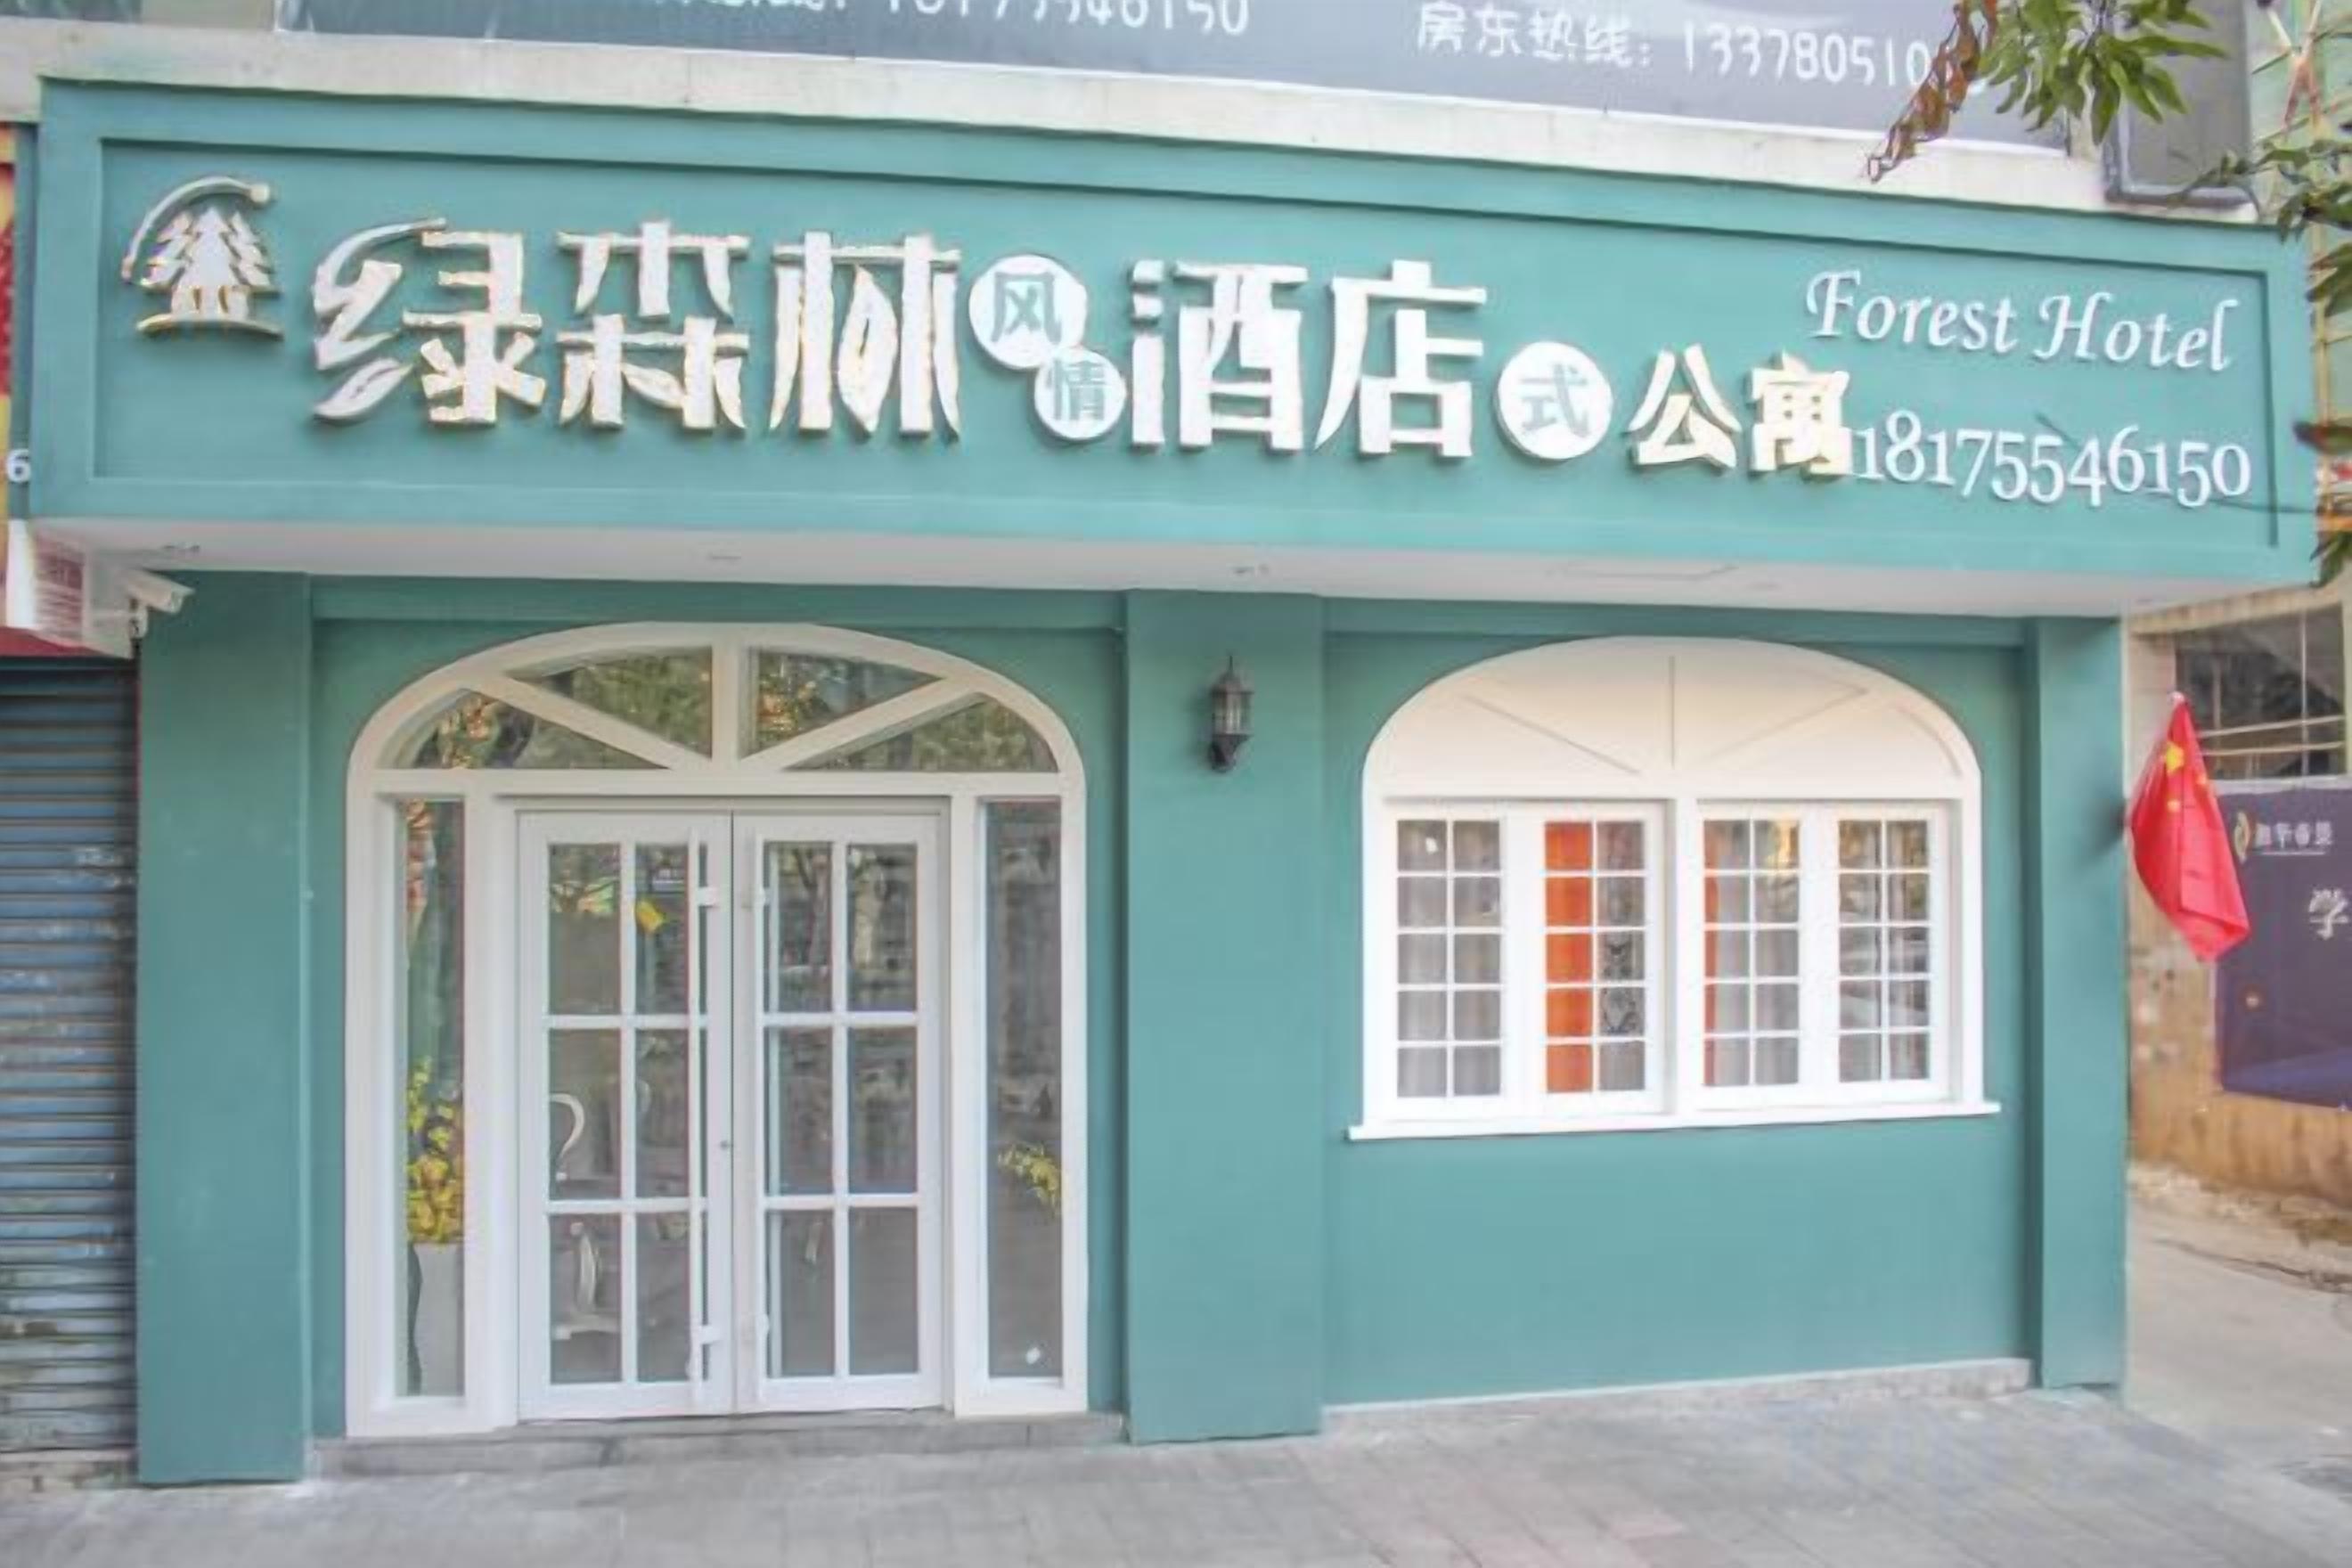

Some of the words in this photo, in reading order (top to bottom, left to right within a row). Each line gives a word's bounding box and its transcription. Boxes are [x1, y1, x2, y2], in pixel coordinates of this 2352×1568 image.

[1806, 268, 2020, 354] Forest
[2032, 291, 2239, 372] Hotel
[1855, 410, 2251, 508] 18175546150
